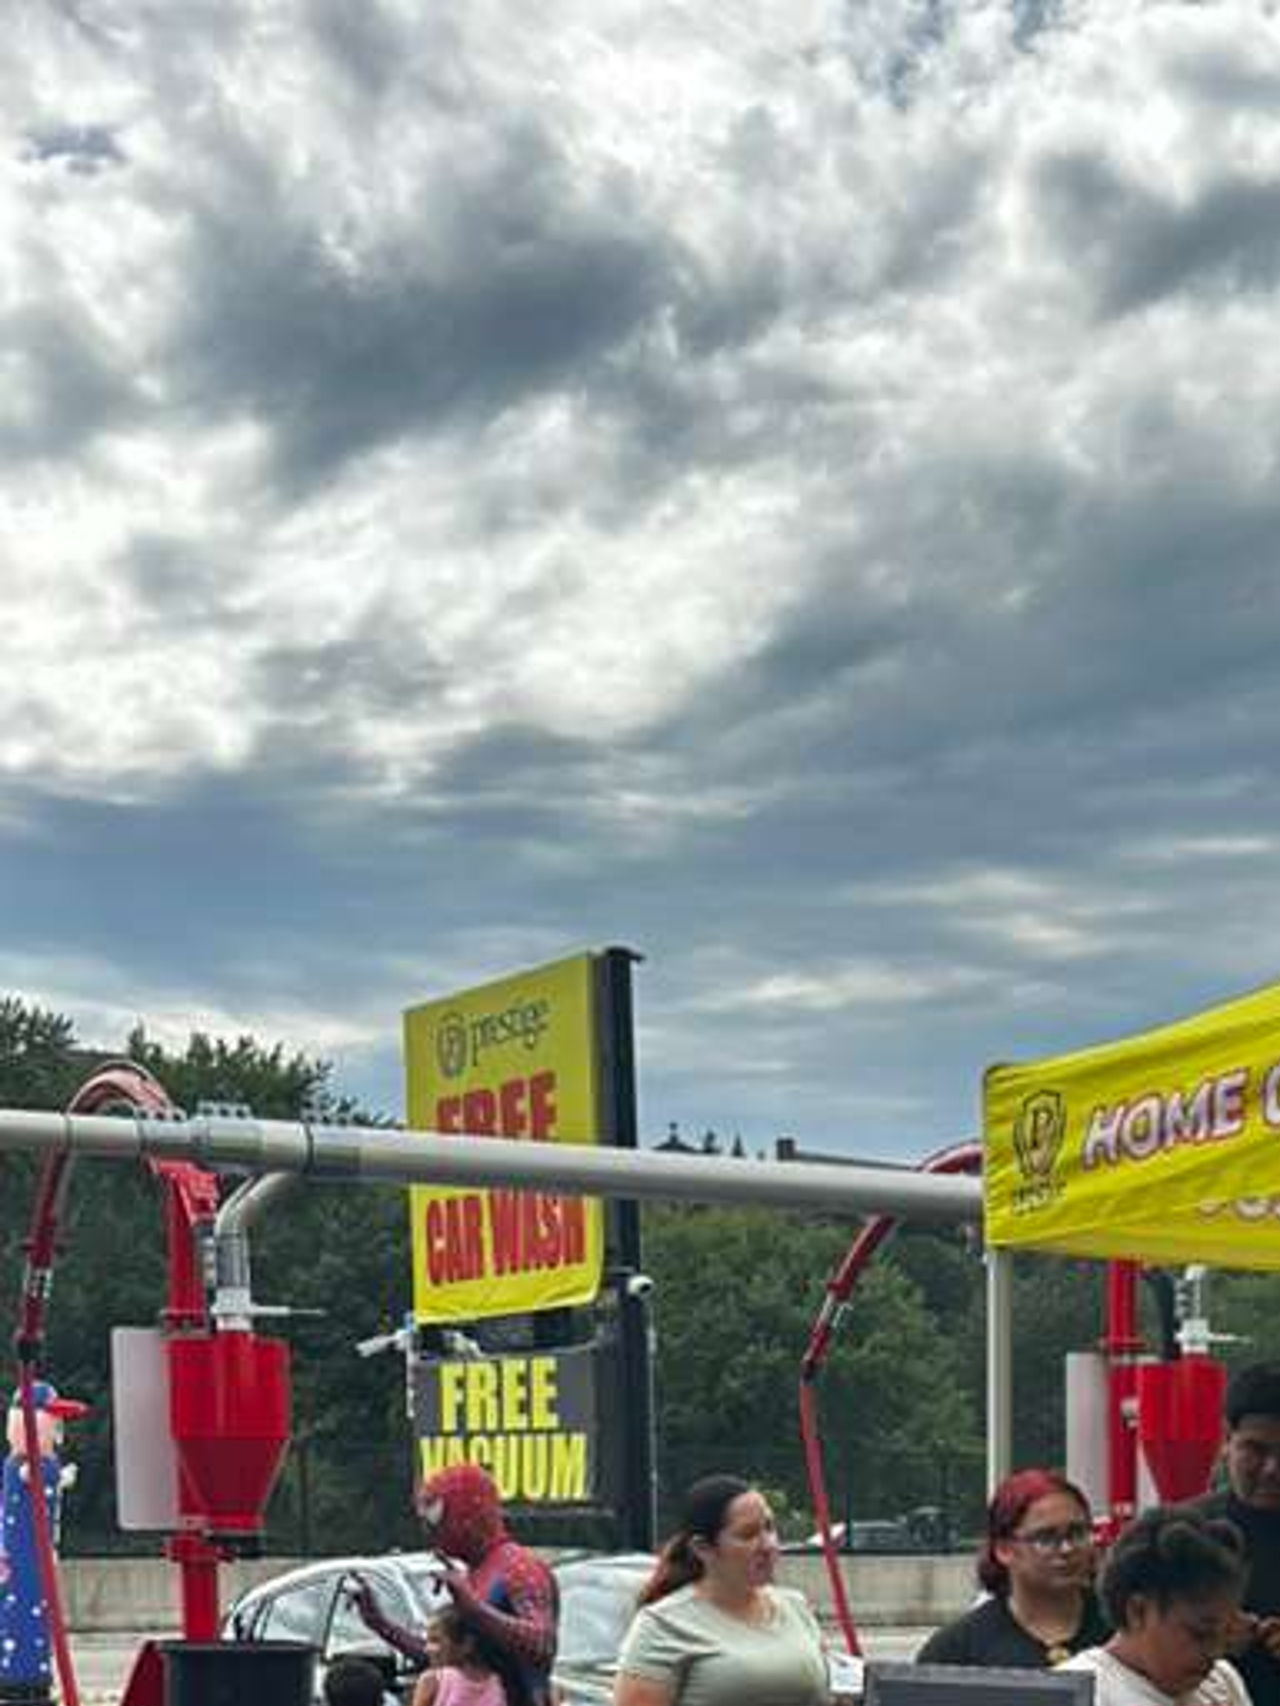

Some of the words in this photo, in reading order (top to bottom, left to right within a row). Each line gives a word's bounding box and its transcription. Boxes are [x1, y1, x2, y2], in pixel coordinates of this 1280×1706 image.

[1083, 1068, 1248, 1171] HOME
[427, 1195, 484, 1286] CAR
[490, 1187, 586, 1277] WASH
[440, 1356, 559, 1431] FREE
